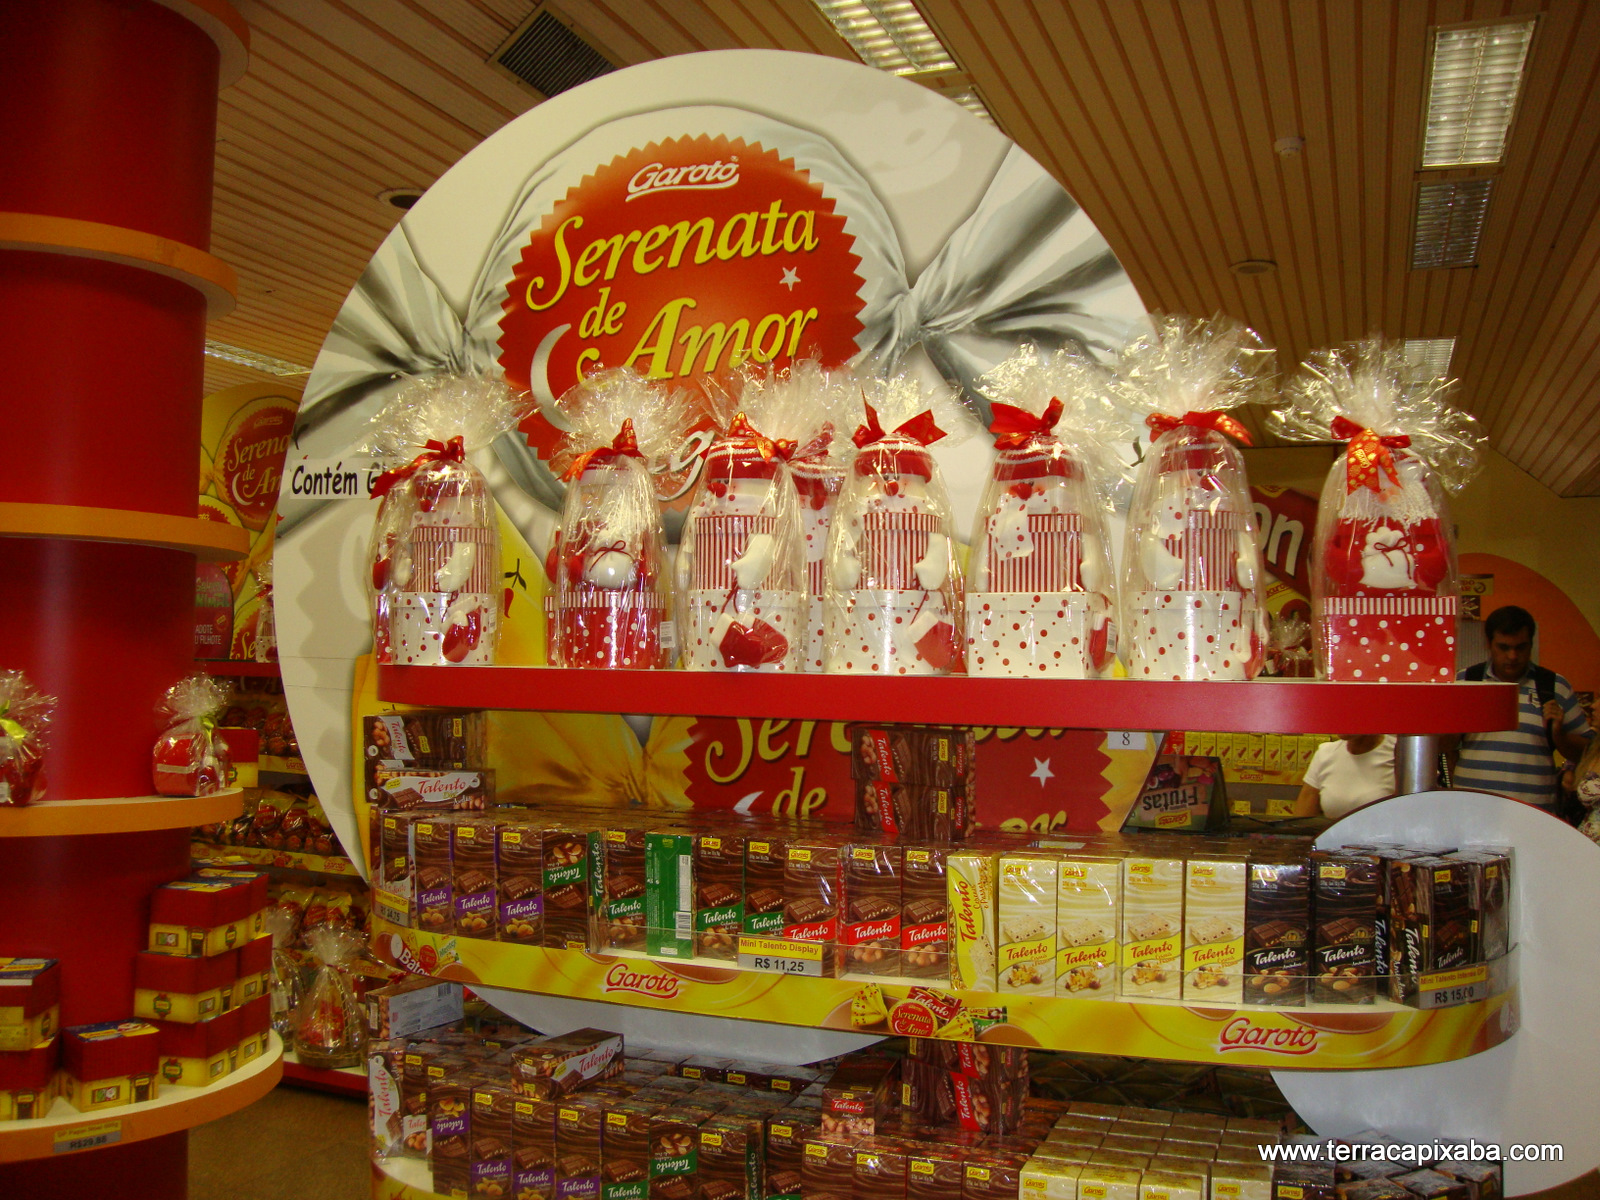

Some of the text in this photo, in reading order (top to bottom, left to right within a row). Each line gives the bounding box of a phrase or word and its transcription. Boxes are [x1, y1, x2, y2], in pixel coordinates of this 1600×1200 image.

[626, 160, 740, 201] Garoto
[526, 199, 819, 311] Serenata
[579, 287, 627, 338] de
[576, 297, 818, 388] Amor
[227, 435, 291, 471] Serena
[243, 464, 255, 481] de
[292, 461, 357, 495] Contém
[1252, 502, 1304, 576] on
[1122, 732, 1130, 746] 8
[878, 737, 891, 776] Talento
[418, 778, 466, 794] Talento
[772, 767, 827, 816] de
[880, 788, 892, 826] Talento
[1143, 786, 1198, 811] Frutas
[548, 867, 581, 883] Talento
[590, 841, 600, 896] Talento
[421, 891, 447, 905] Talento
[461, 895, 490, 910] Talento
[506, 901, 538, 916] Talento
[609, 900, 642, 915] Talento
[961, 880, 978, 943] Talento
[703, 909, 737, 924] Talento
[791, 925, 829, 940] Talento
[855, 923, 893, 939] Talento
[909, 926, 947, 942] Talento
[740, 939, 819, 955] Mini Talento Display
[1006, 944, 1048, 961] Talento
[1131, 941, 1173, 958] Talento
[1193, 944, 1235, 962] Talento
[1323, 945, 1365, 963] Talento
[1375, 919, 1389, 974] Talento
[754, 957, 804, 972] R$ 11,25
[1065, 949, 1107, 965] Talento
[1254, 948, 1296, 965] Talento
[1405, 928, 1420, 984] Talento
[1437, 946, 1464, 968] Talento
[604, 963, 679, 1000] Garoto
[1421, 976, 1434, 985] Mini
[1435, 974, 1456, 983] Talento
[915, 992, 949, 1016] Talento
[1435, 990, 1448, 1004] R$
[894, 1008, 932, 1023] Serenata
[900, 1023, 929, 1035] Amor
[1220, 1017, 1318, 1055] Garoto
[579, 1048, 614, 1074] Talento
[375, 1069, 392, 1117] Talento
[960, 1080, 972, 1119] Talento
[834, 1100, 864, 1112] Talento
[408, 1119, 427, 1129] Talen
[436, 1120, 465, 1131] Talento
[477, 1163, 507, 1175] Talento
[656, 1159, 691, 1172] Talento
[518, 1172, 549, 1185] Talento
[562, 1180, 594, 1193] Talento
[608, 1185, 642, 1199] Talento
